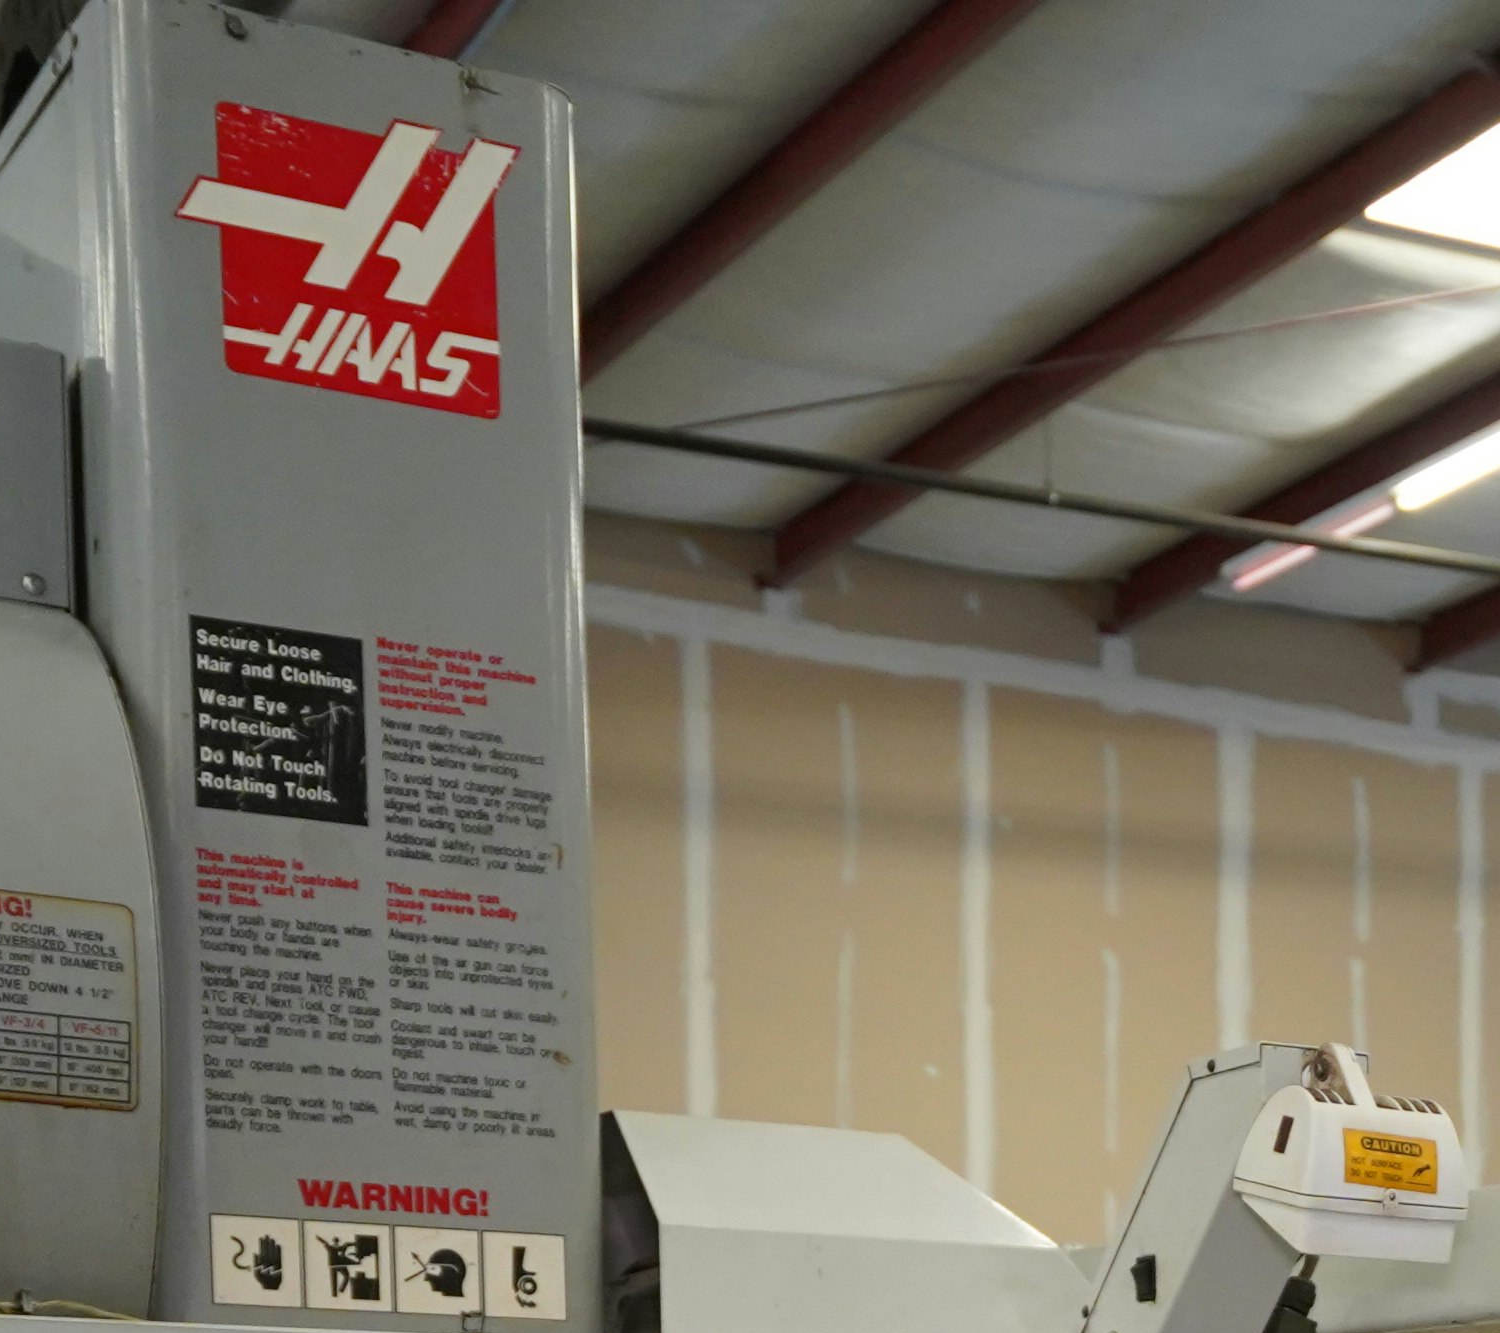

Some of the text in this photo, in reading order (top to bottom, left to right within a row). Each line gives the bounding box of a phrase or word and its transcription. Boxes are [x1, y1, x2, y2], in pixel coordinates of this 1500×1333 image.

[222, 303, 500, 397] HAAS
[196, 629, 322, 661] Secure Loose
[376, 637, 504, 664] Never operate or
[196, 653, 358, 693] Hair and Clothing.
[379, 668, 486, 691] without proper
[446, 661, 471, 675] this
[478, 669, 537, 685] machine
[198, 687, 288, 715] Wear Eye
[462, 694, 487, 706] and
[198, 713, 297, 740] Protection.
[200, 746, 326, 776] Do Not Touch
[199, 771, 338, 803] Rotating Tools.
[196, 848, 304, 870] This machine is
[196, 864, 360, 890] automatically controlled
[197, 878, 315, 899] and may start at
[386, 881, 500, 904] This machine can
[387, 898, 518, 922] cause severe bodily
[66, 928, 104, 942] WHEN
[41, 955, 54, 965] IN
[60, 956, 124, 972] DIAMETER
[28, 981, 69, 995] DOWN
[75, 986, 82, 996] 4
[1362, 1138, 1421, 1155] CAUTION
[297, 1178, 490, 1217] WARNING!
